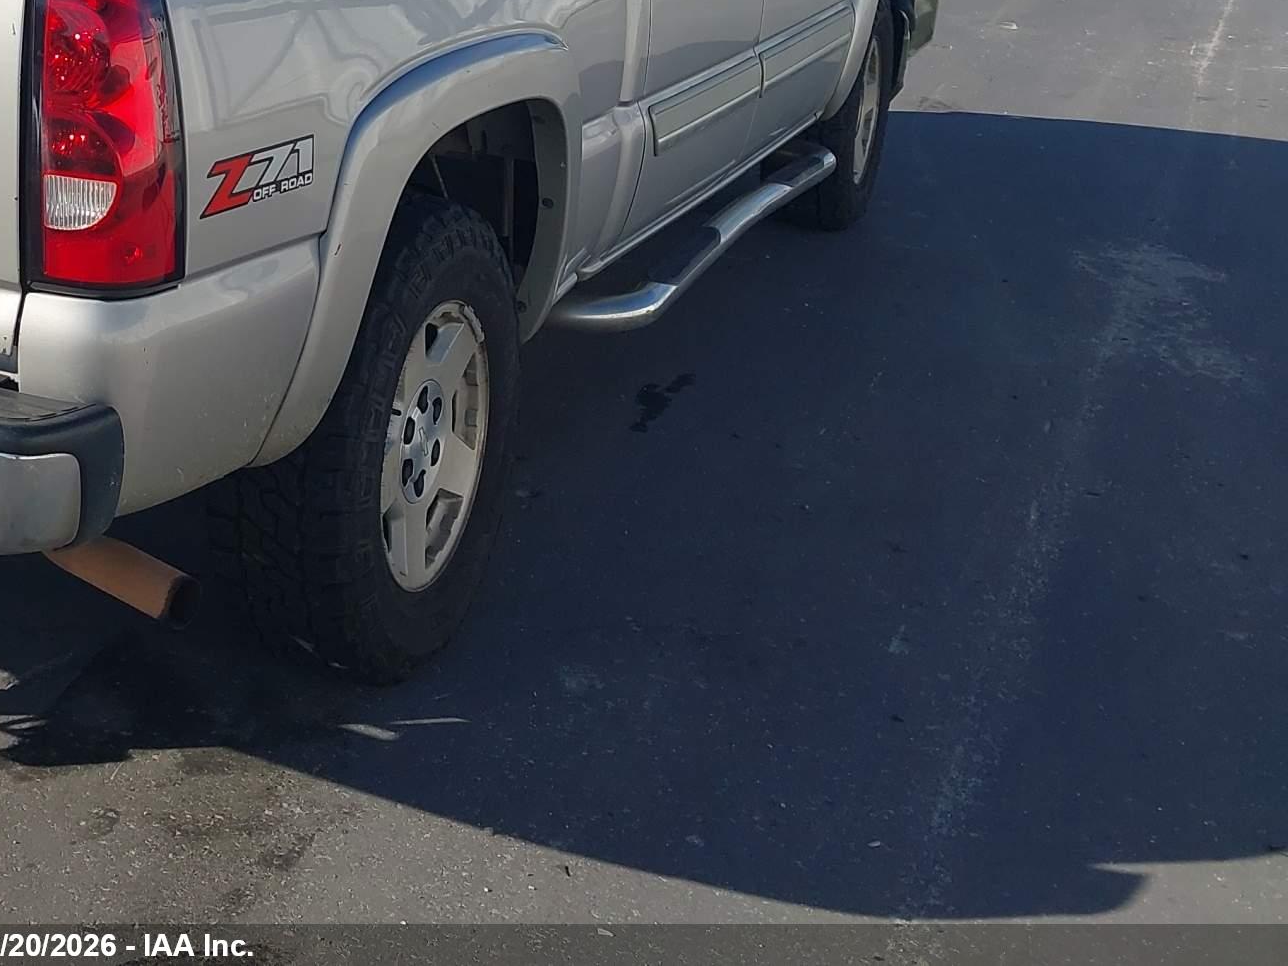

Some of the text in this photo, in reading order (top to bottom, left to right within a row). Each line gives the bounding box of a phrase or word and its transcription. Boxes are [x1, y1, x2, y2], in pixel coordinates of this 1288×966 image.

[200, 134, 314, 219] Z71
[252, 172, 313, 202] OFF ROAD
